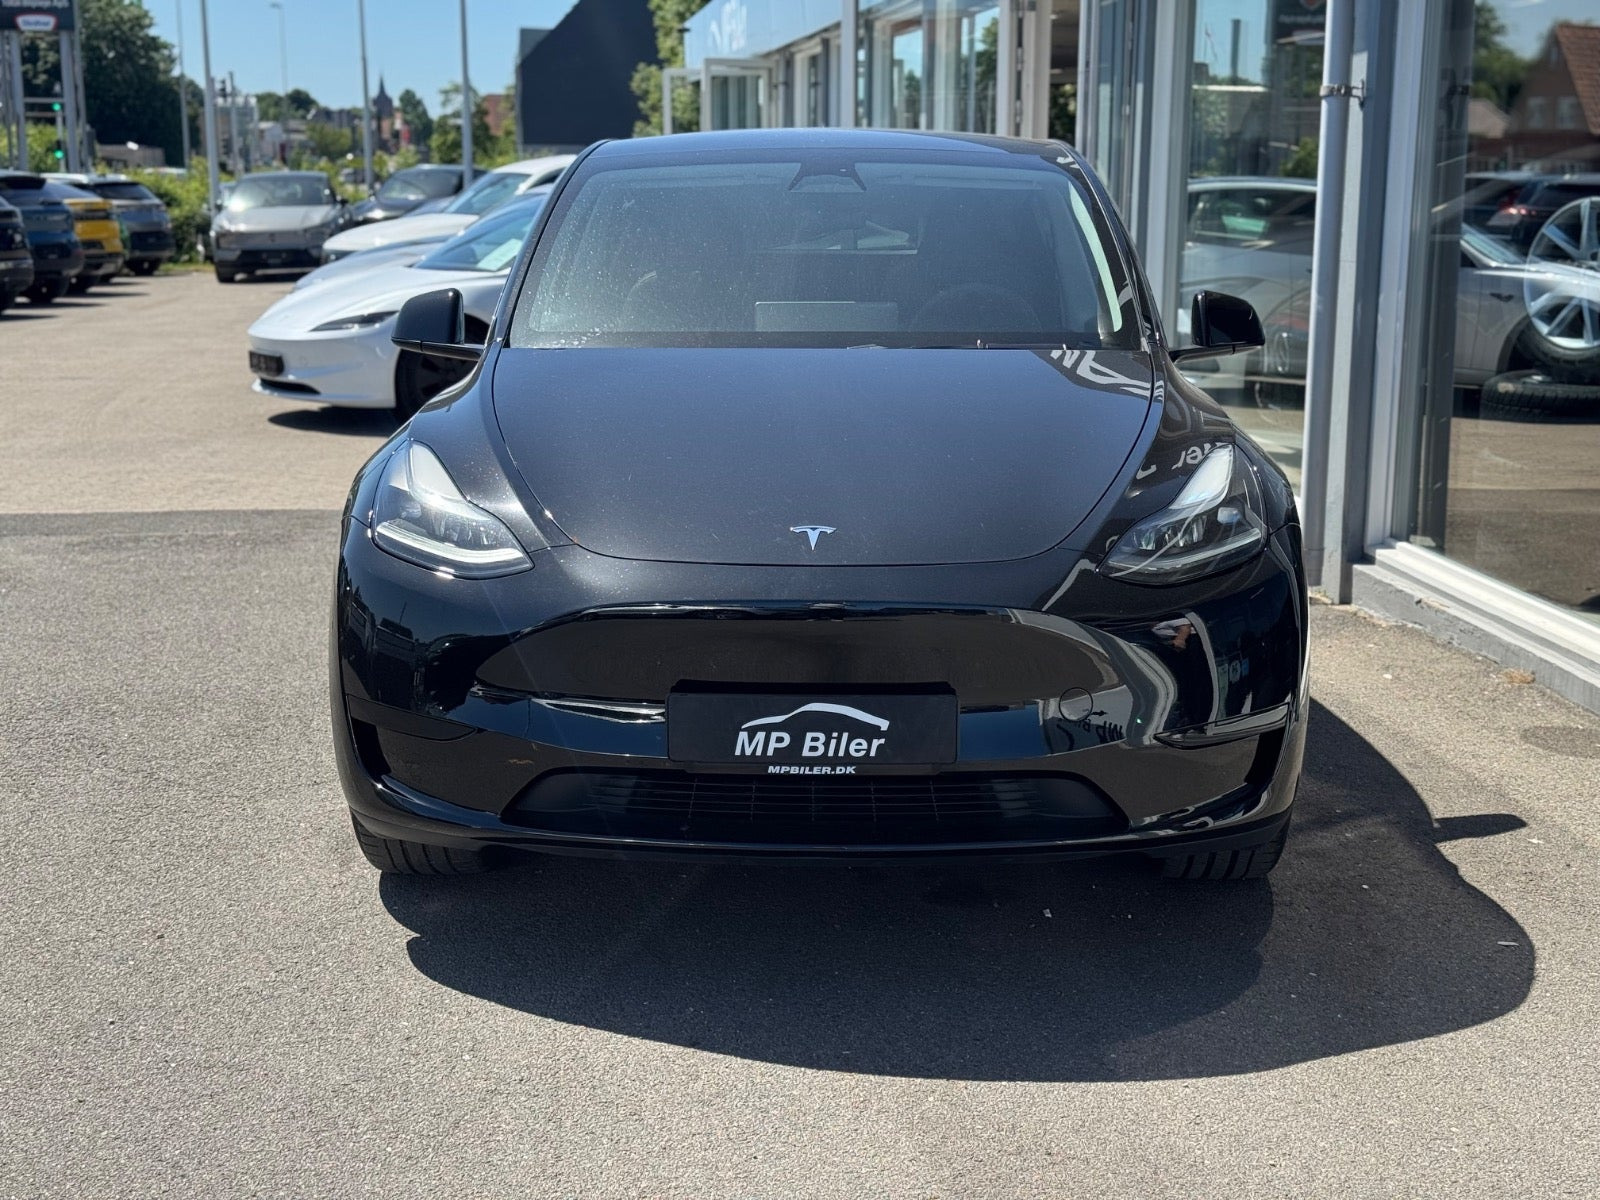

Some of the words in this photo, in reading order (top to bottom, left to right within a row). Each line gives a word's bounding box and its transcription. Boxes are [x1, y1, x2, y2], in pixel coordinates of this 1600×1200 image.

[735, 731, 790, 757] MP
[802, 731, 885, 757] Biler
[767, 765, 856, 775] MPBILER.DK
